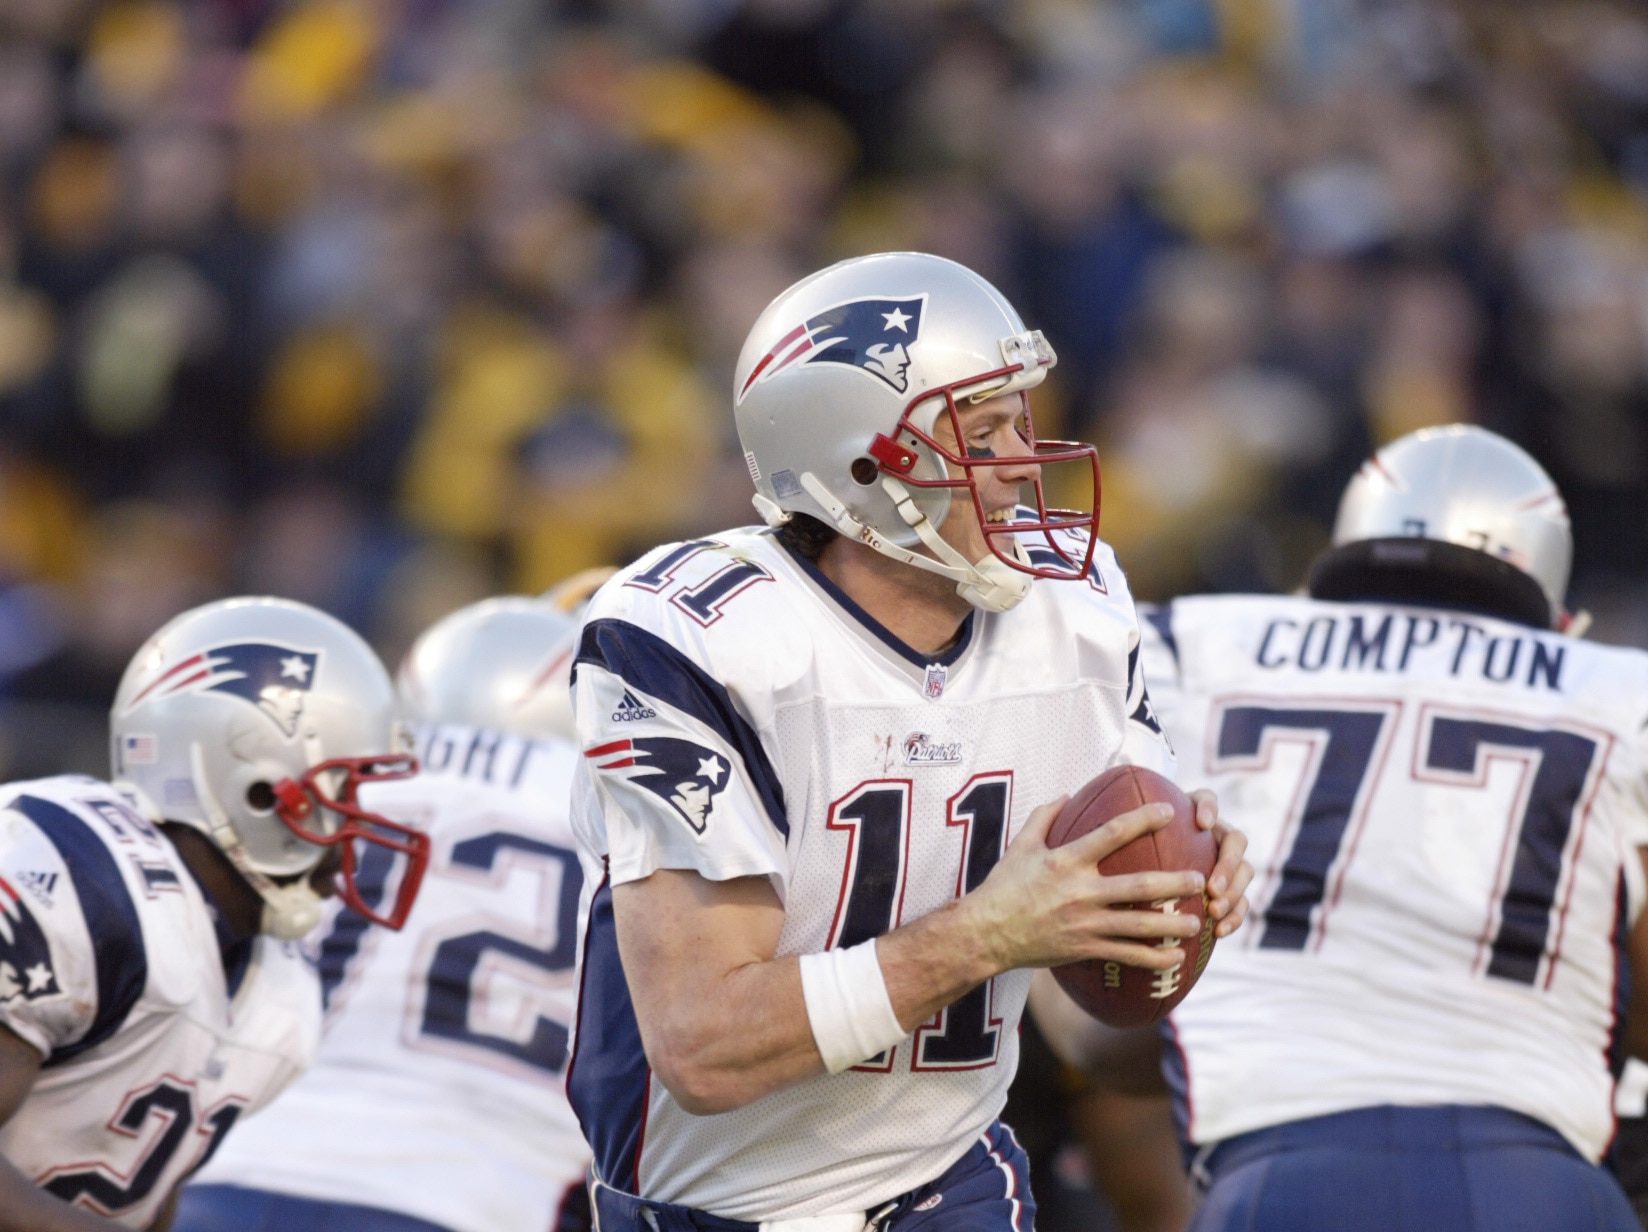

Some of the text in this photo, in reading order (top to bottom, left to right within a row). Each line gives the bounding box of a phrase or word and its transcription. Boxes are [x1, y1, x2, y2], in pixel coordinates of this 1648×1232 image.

[623, 539, 775, 629] 11
[1255, 612, 1566, 692] COMPTON
[611, 708, 657, 723] adidas
[905, 742, 963, 764] Patriots
[420, 727, 552, 788] GHT
[1204, 694, 1617, 992] 77
[826, 769, 1014, 1073] 11
